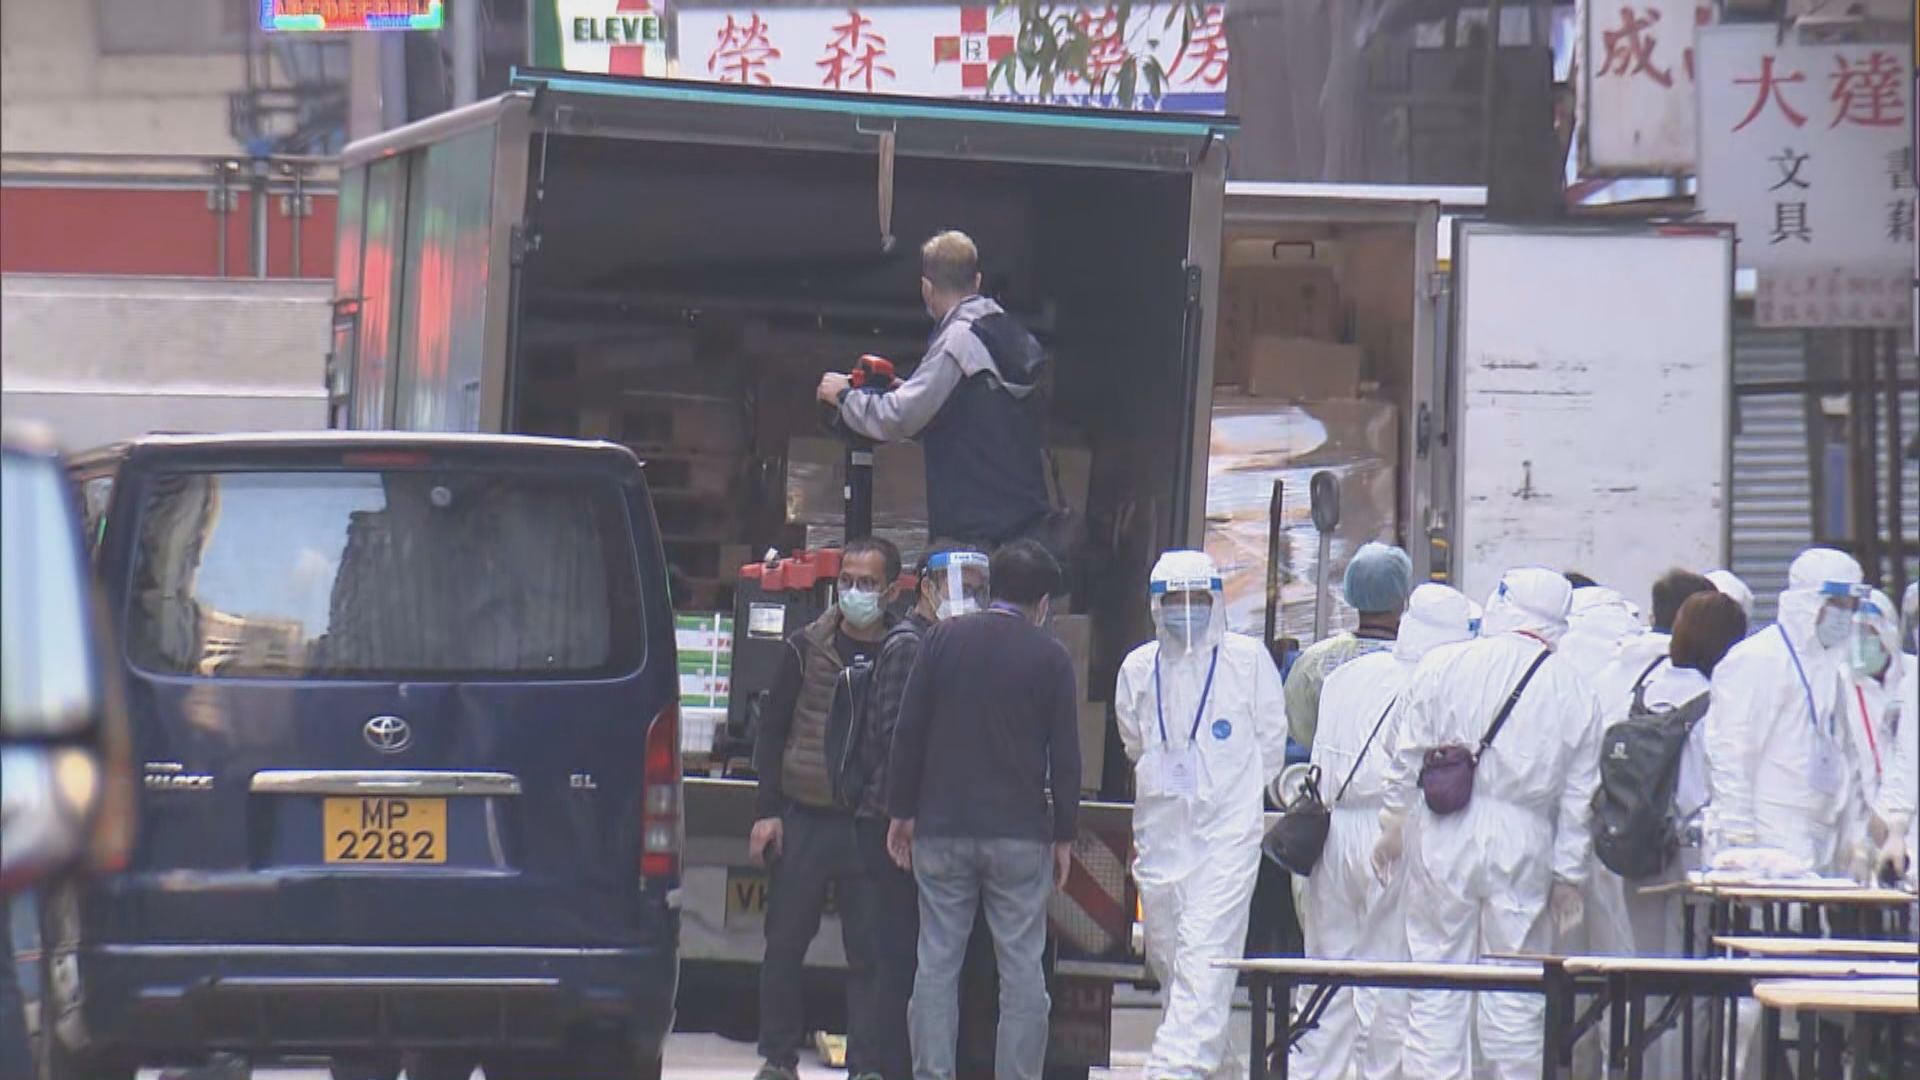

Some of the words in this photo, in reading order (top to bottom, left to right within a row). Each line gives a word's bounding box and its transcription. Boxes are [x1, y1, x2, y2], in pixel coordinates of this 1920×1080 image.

[708, 11, 895, 94] 榮森
[1732, 52, 1905, 132] 大達
[1767, 148, 1812, 245] 文具
[336, 831, 434, 859] 2282
[361, 800, 409, 829] MP
